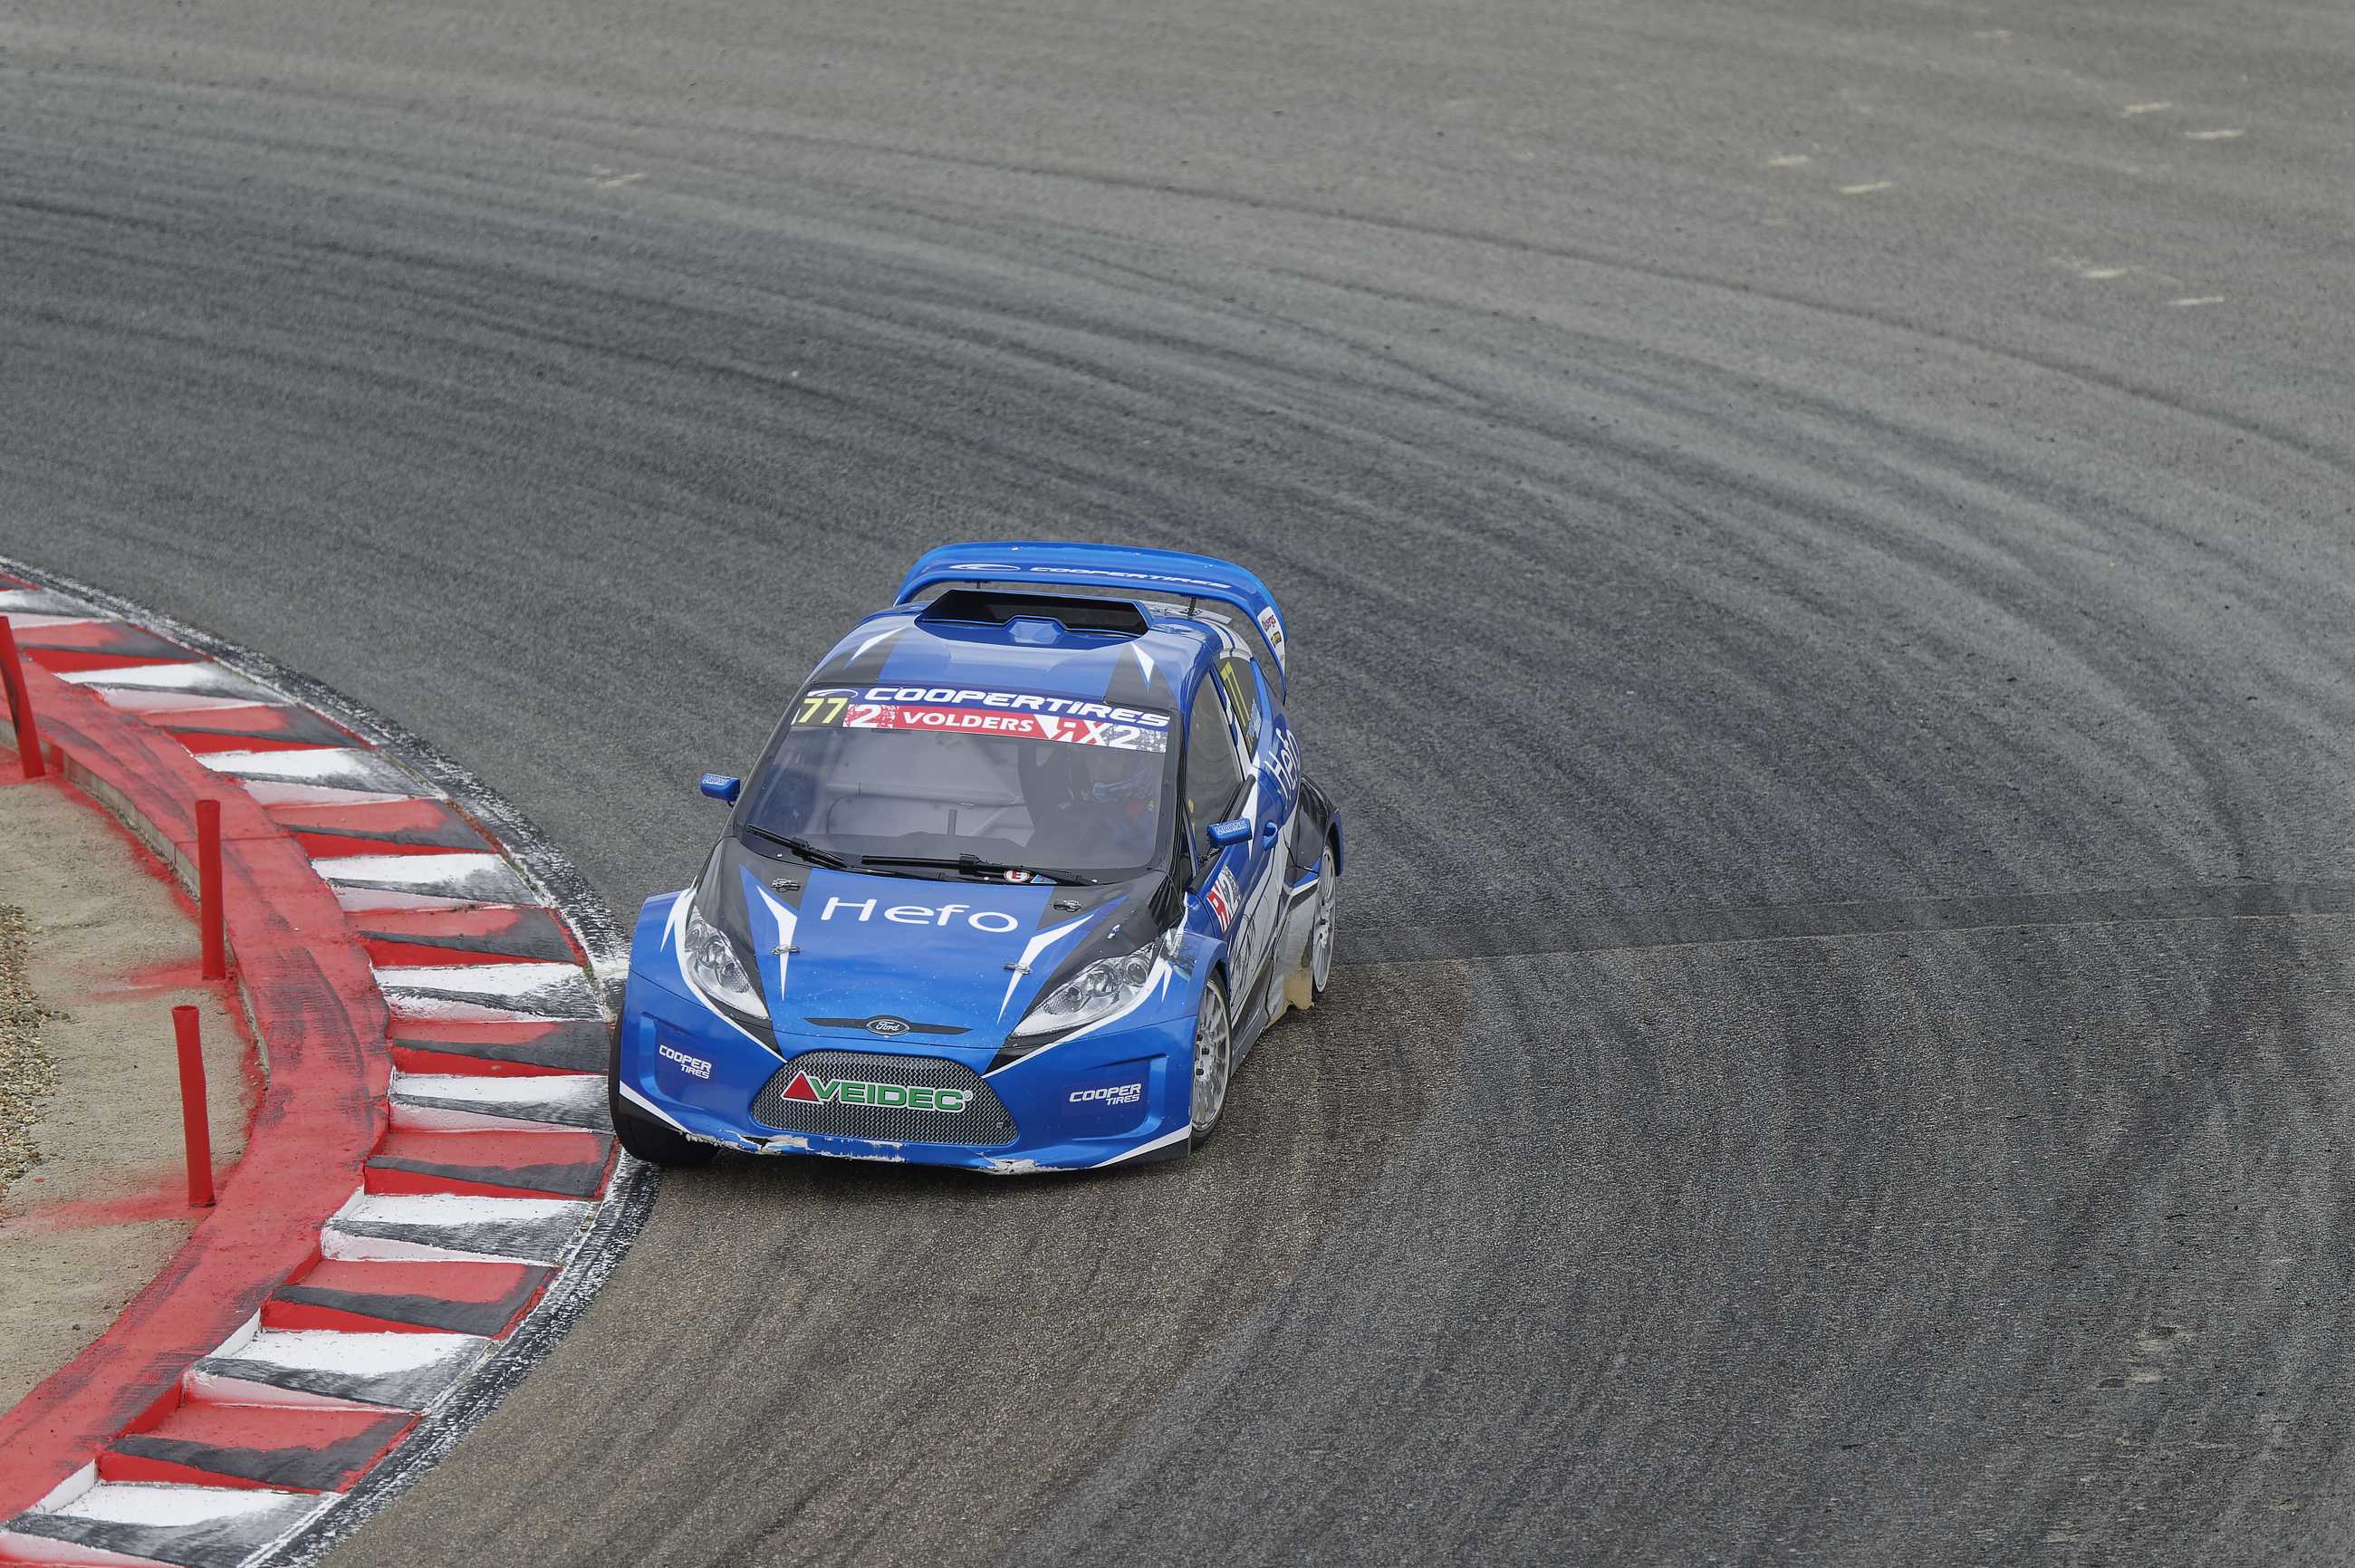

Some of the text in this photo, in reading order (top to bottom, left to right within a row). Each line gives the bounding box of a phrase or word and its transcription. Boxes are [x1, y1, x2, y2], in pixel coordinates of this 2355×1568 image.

[798, 697, 848, 724] 77
[903, 711, 1034, 732] VOLDERS
[821, 897, 1018, 933] Hefo
[875, 1020, 900, 1032] Ford
[658, 1044, 712, 1073] COOPER
[681, 1063, 710, 1079] TIRES
[808, 1076, 965, 1111] VEIDEC
[1069, 1082, 1141, 1102] COOPER
[1105, 1093, 1140, 1105] TIRES
